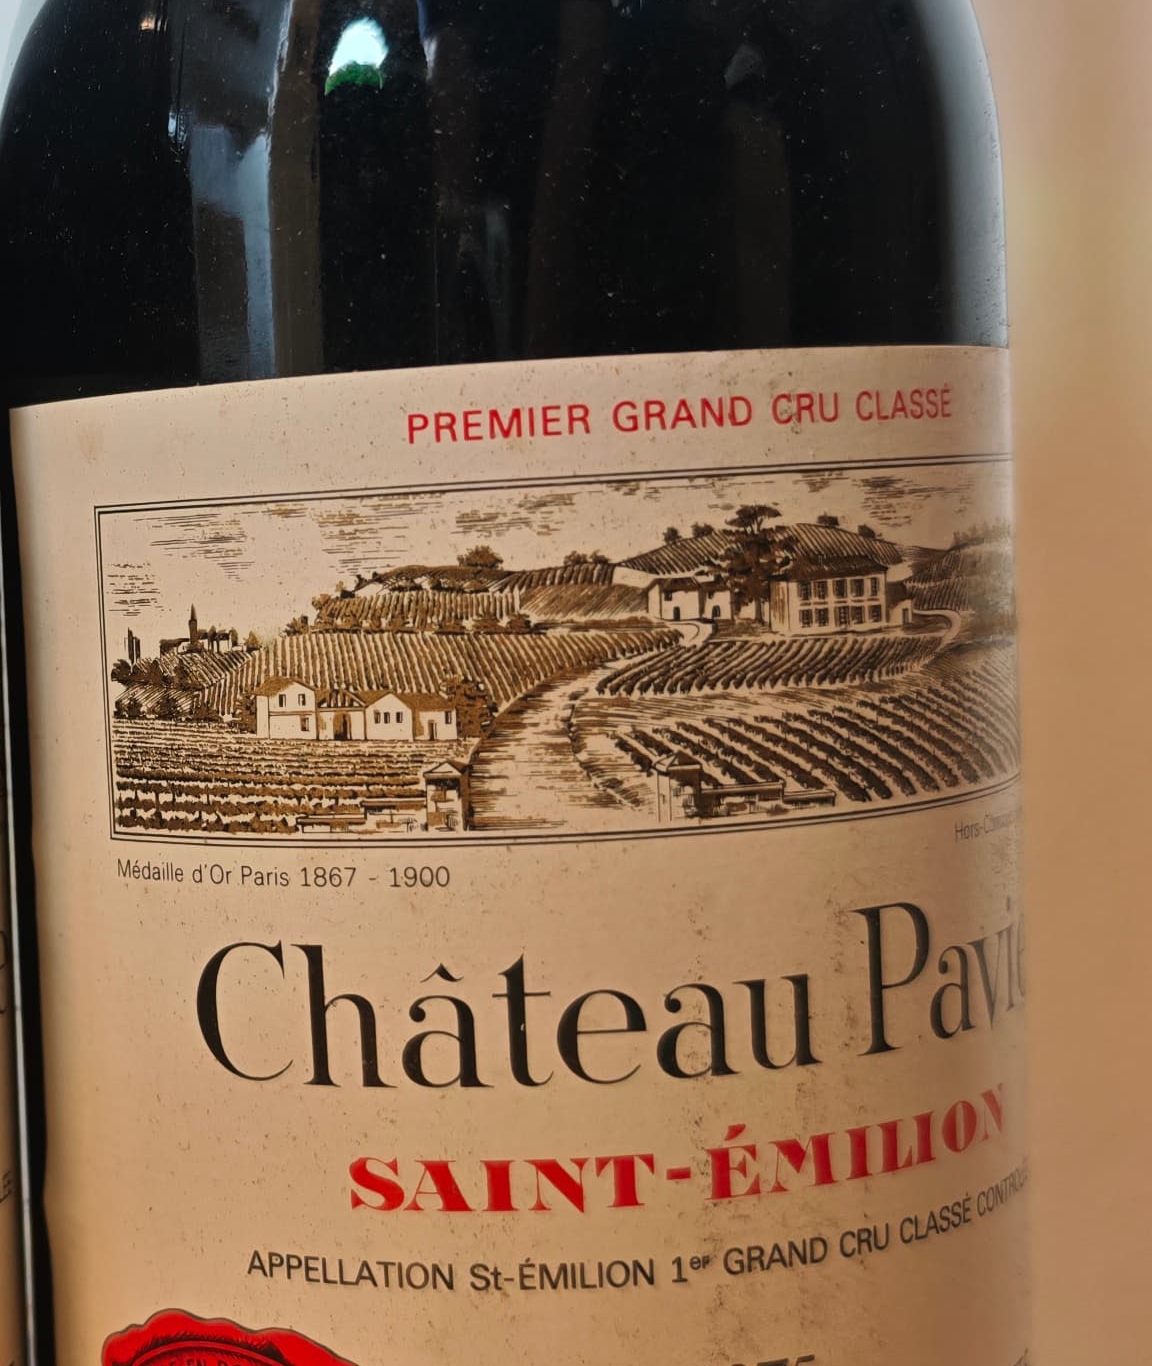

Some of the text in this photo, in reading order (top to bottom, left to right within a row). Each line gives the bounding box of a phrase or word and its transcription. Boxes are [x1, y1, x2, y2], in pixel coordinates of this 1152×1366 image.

[407, 383, 953, 444] PREMIER GRAND CRU CLASSÉ
[117, 858, 184, 883] Médaille
[192, 863, 232, 885] d'Or
[241, 865, 290, 887] Paris
[300, 866, 357, 888] 1867
[389, 865, 450, 888] 1900
[195, 939, 823, 1089] Château
[349, 1086, 1005, 1214] SAINT-ÉMILION
[247, 1249, 454, 1291] APPELLATION
[469, 1257, 656, 1291] St-ÉMILION
[671, 1255, 711, 1284] 1er
[723, 1236, 828, 1276] GRAND
[839, 1222, 891, 1259] CRU
[899, 1192, 972, 1244] CLASSÉ
